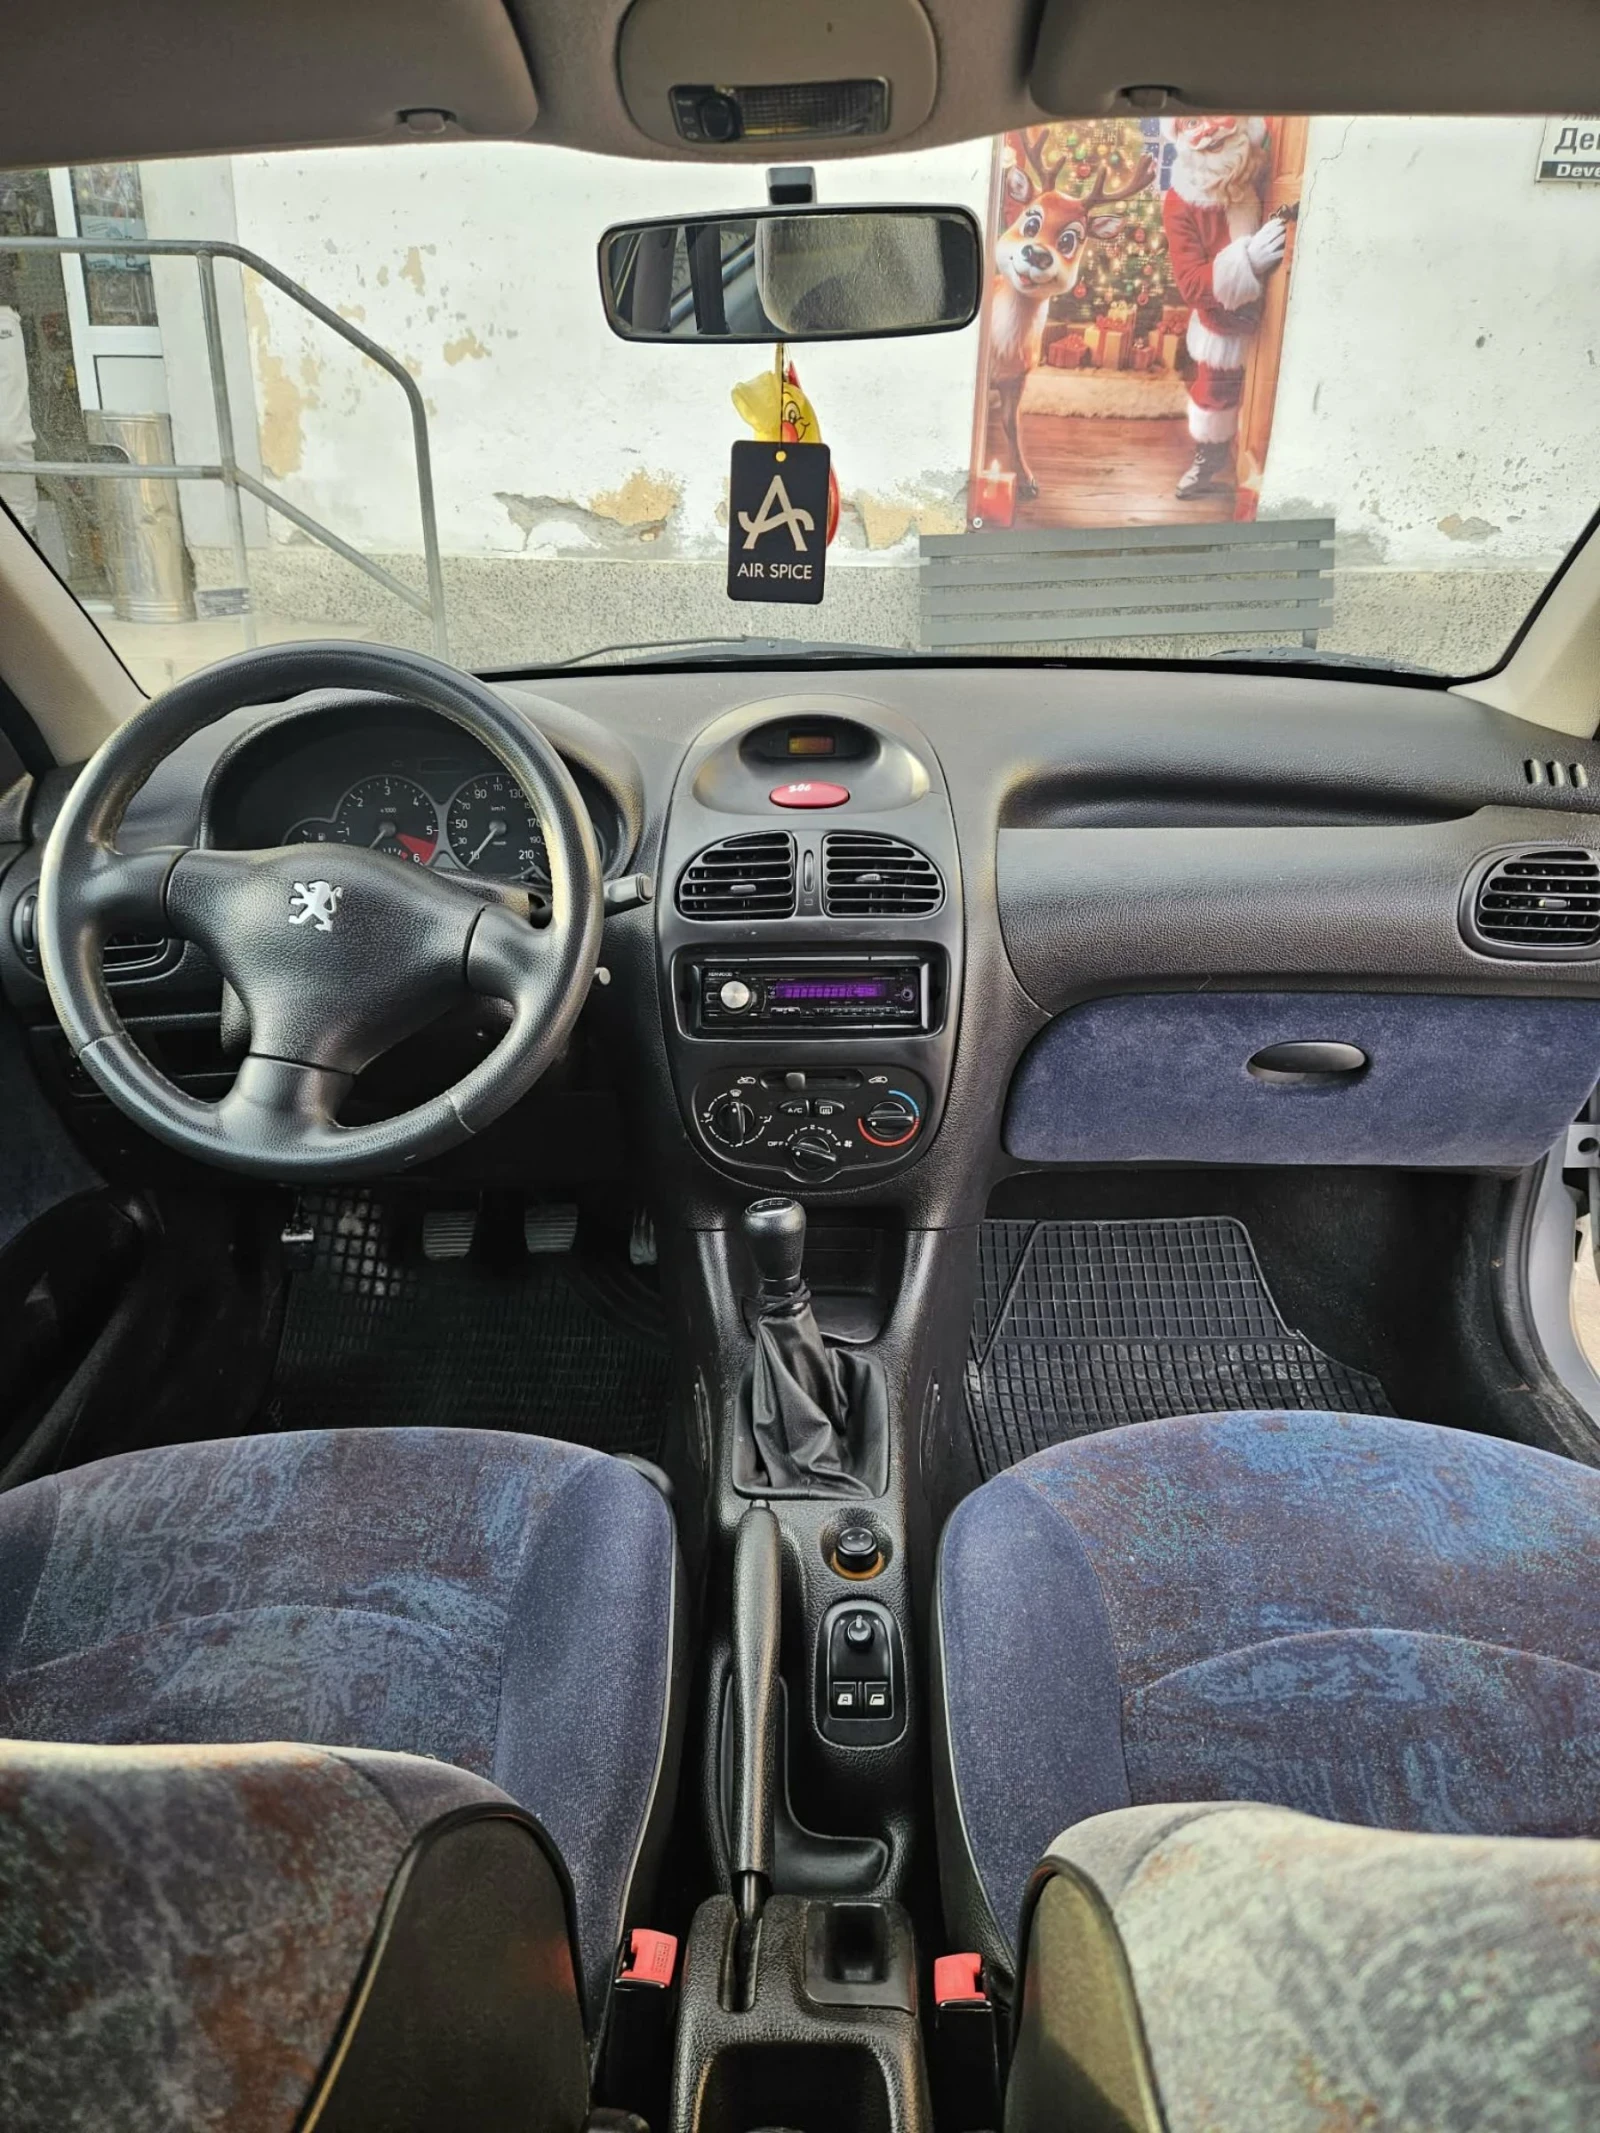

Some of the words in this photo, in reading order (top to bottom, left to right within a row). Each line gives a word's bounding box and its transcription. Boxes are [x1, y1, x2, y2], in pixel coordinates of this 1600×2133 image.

[1553, 127, 1600, 155] Де
[737, 563, 765, 578] AIR
[769, 563, 813, 580] SPICE
[384, 786, 391, 796] 3
[788, 783, 812, 793] 206
[474, 789, 487, 799] 90
[509, 789, 524, 799] 130
[357, 798, 364, 808] 2
[413, 797, 419, 807] 4
[462, 802, 471, 811] 70
[455, 819, 468, 829] 50
[426, 825, 433, 835] 5
[530, 836, 542, 844] 190
[413, 853, 420, 863] 6
[518, 849, 534, 860] 210
